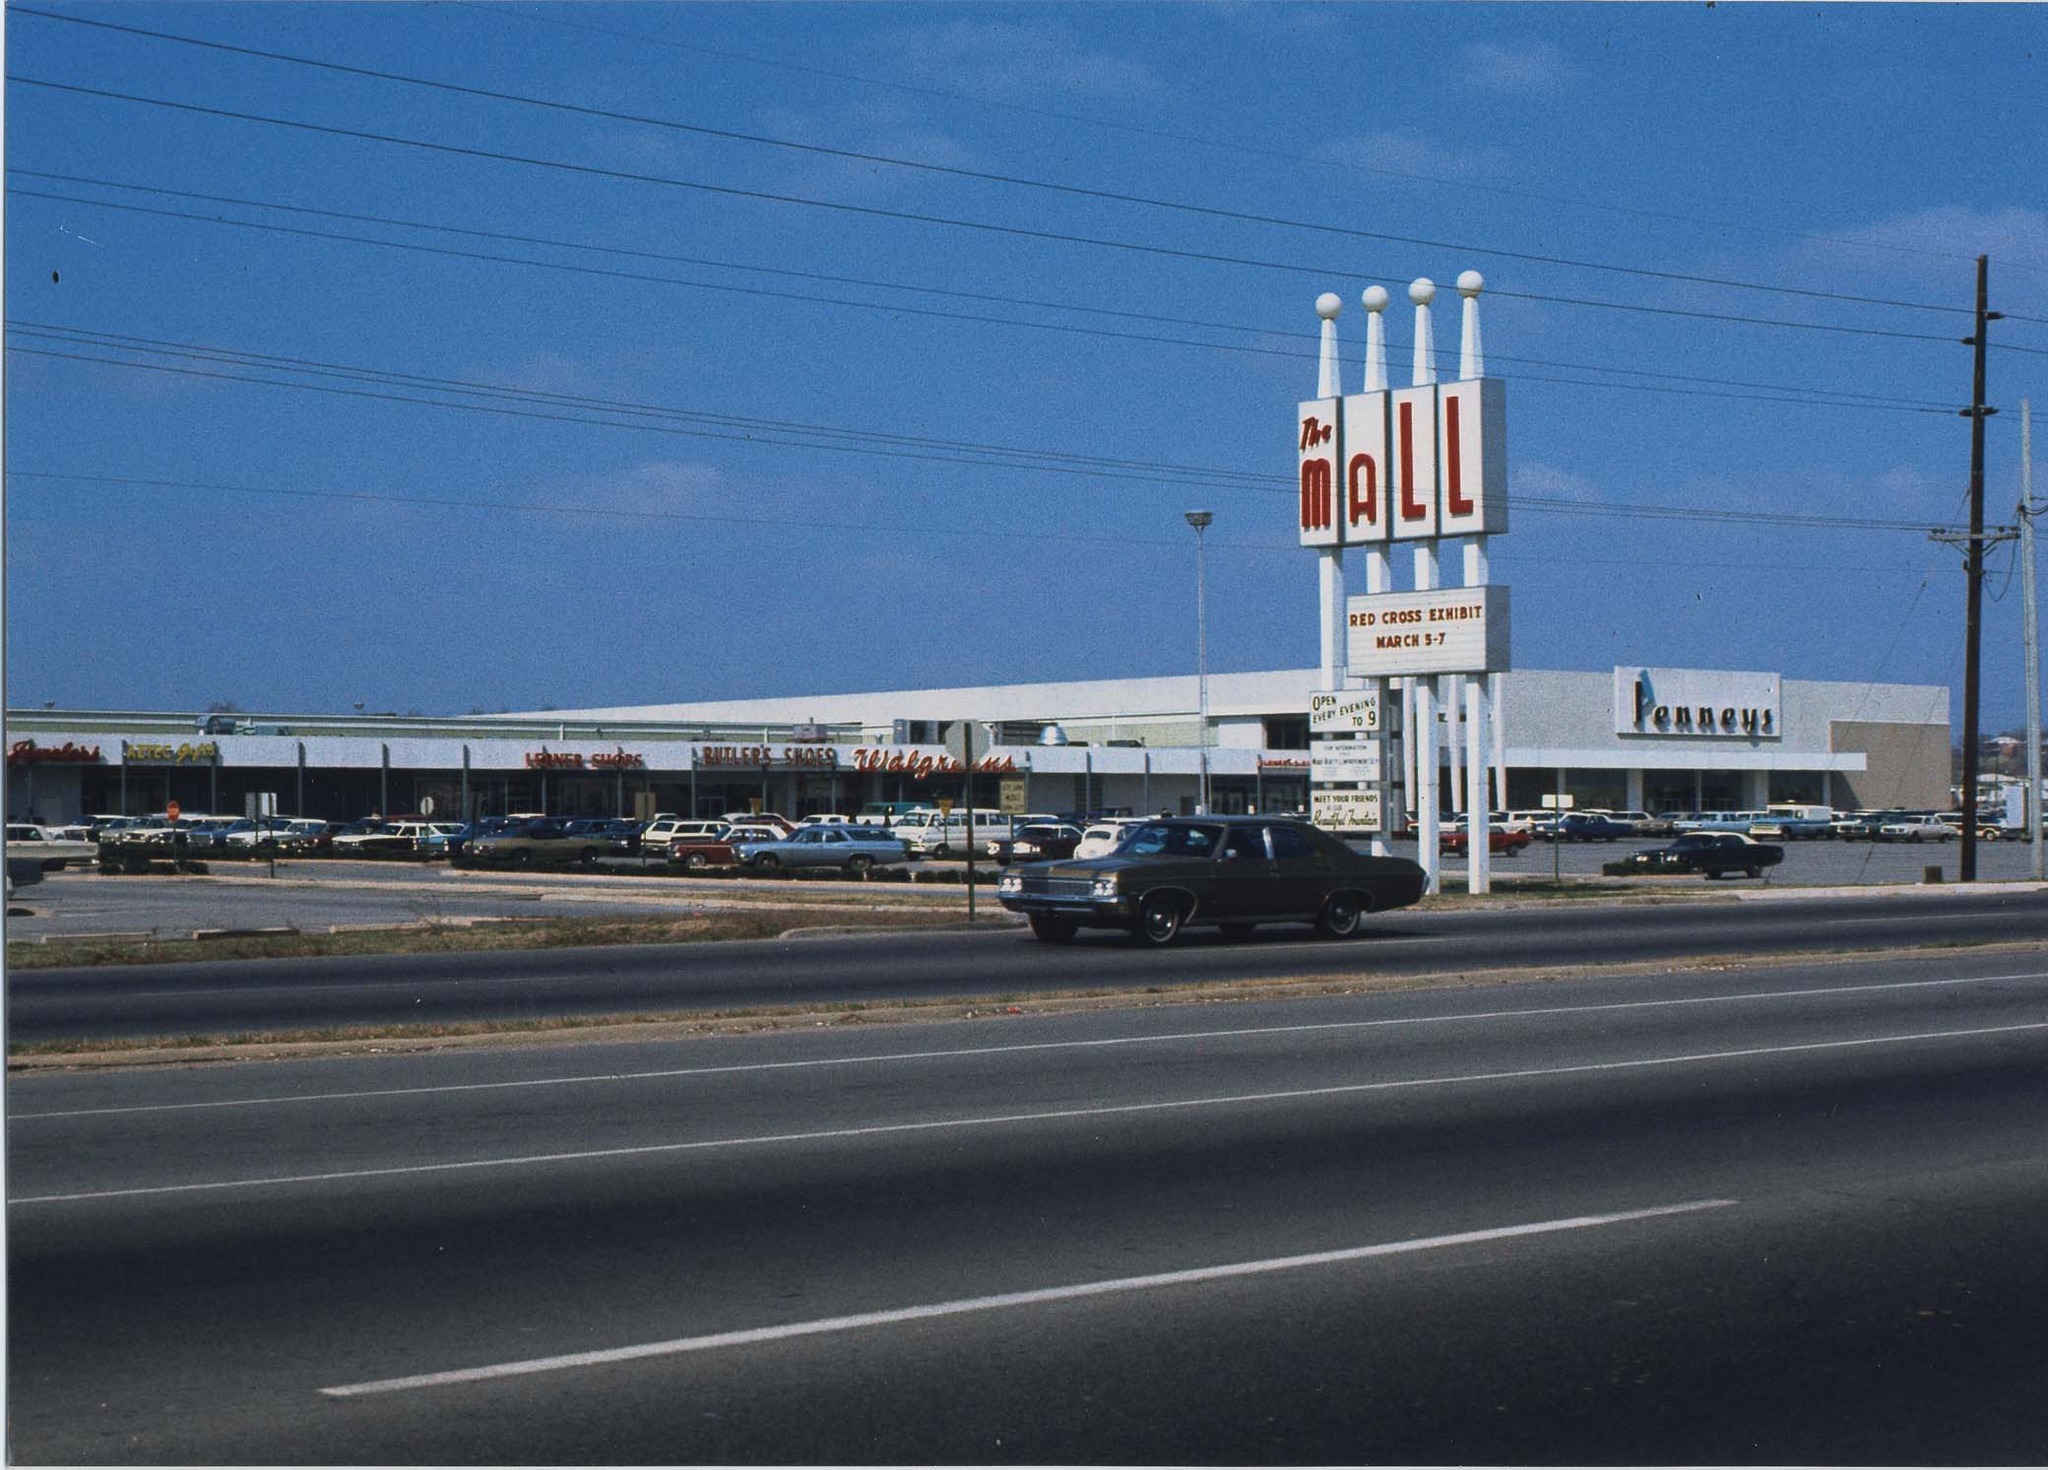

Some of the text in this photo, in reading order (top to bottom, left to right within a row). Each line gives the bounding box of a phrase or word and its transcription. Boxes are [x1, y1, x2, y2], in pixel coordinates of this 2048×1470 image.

[1299, 416, 1332, 452] The
[1301, 395, 1474, 531] MALL
[1349, 605, 1482, 627] RED CROSS EXHIBIT
[1376, 632, 1446, 649] MARCH 5-7
[1313, 697, 1376, 724] EVERY EVENING
[1352, 711, 1376, 726] TO 9
[703, 745, 834, 765] BUTLER'S SHOES
[1333, 795, 1350, 803] YOUR
[1351, 795, 1378, 803] FRIENDS
